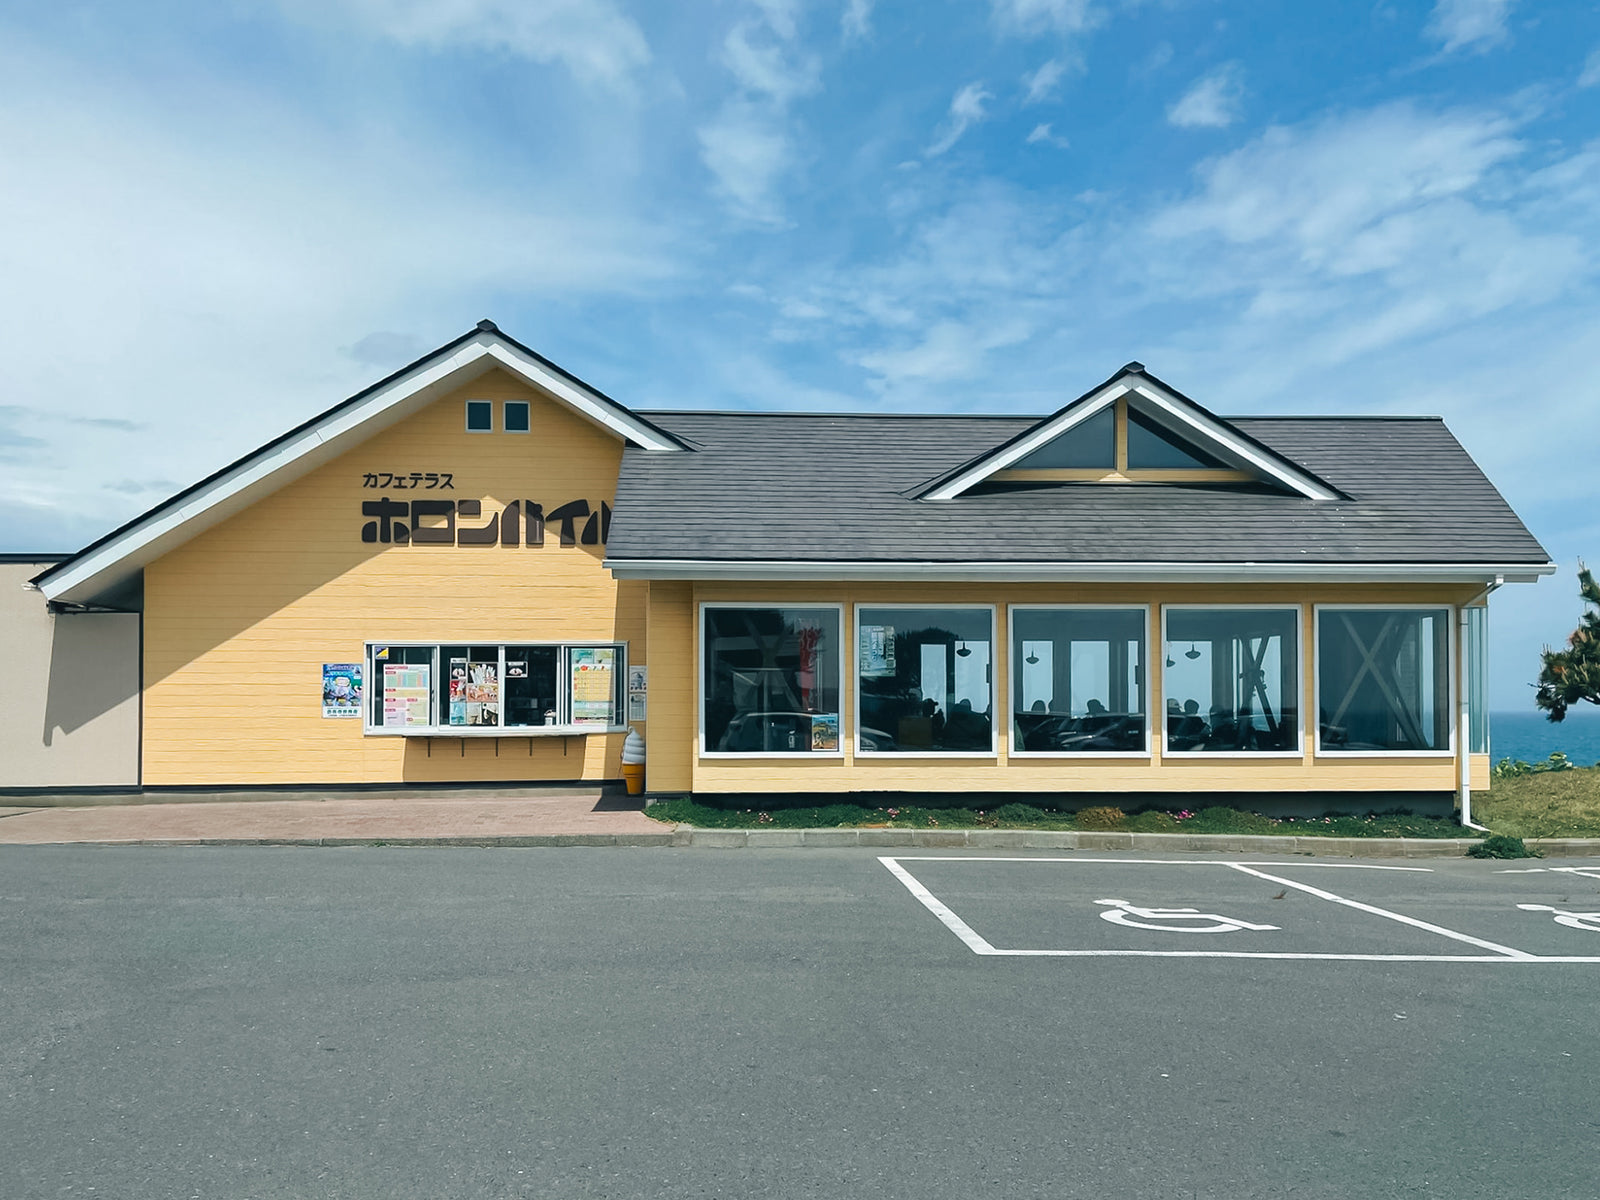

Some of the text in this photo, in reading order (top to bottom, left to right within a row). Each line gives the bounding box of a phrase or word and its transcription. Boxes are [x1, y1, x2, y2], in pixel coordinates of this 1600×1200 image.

[363, 473, 455, 489] カフェテラス
